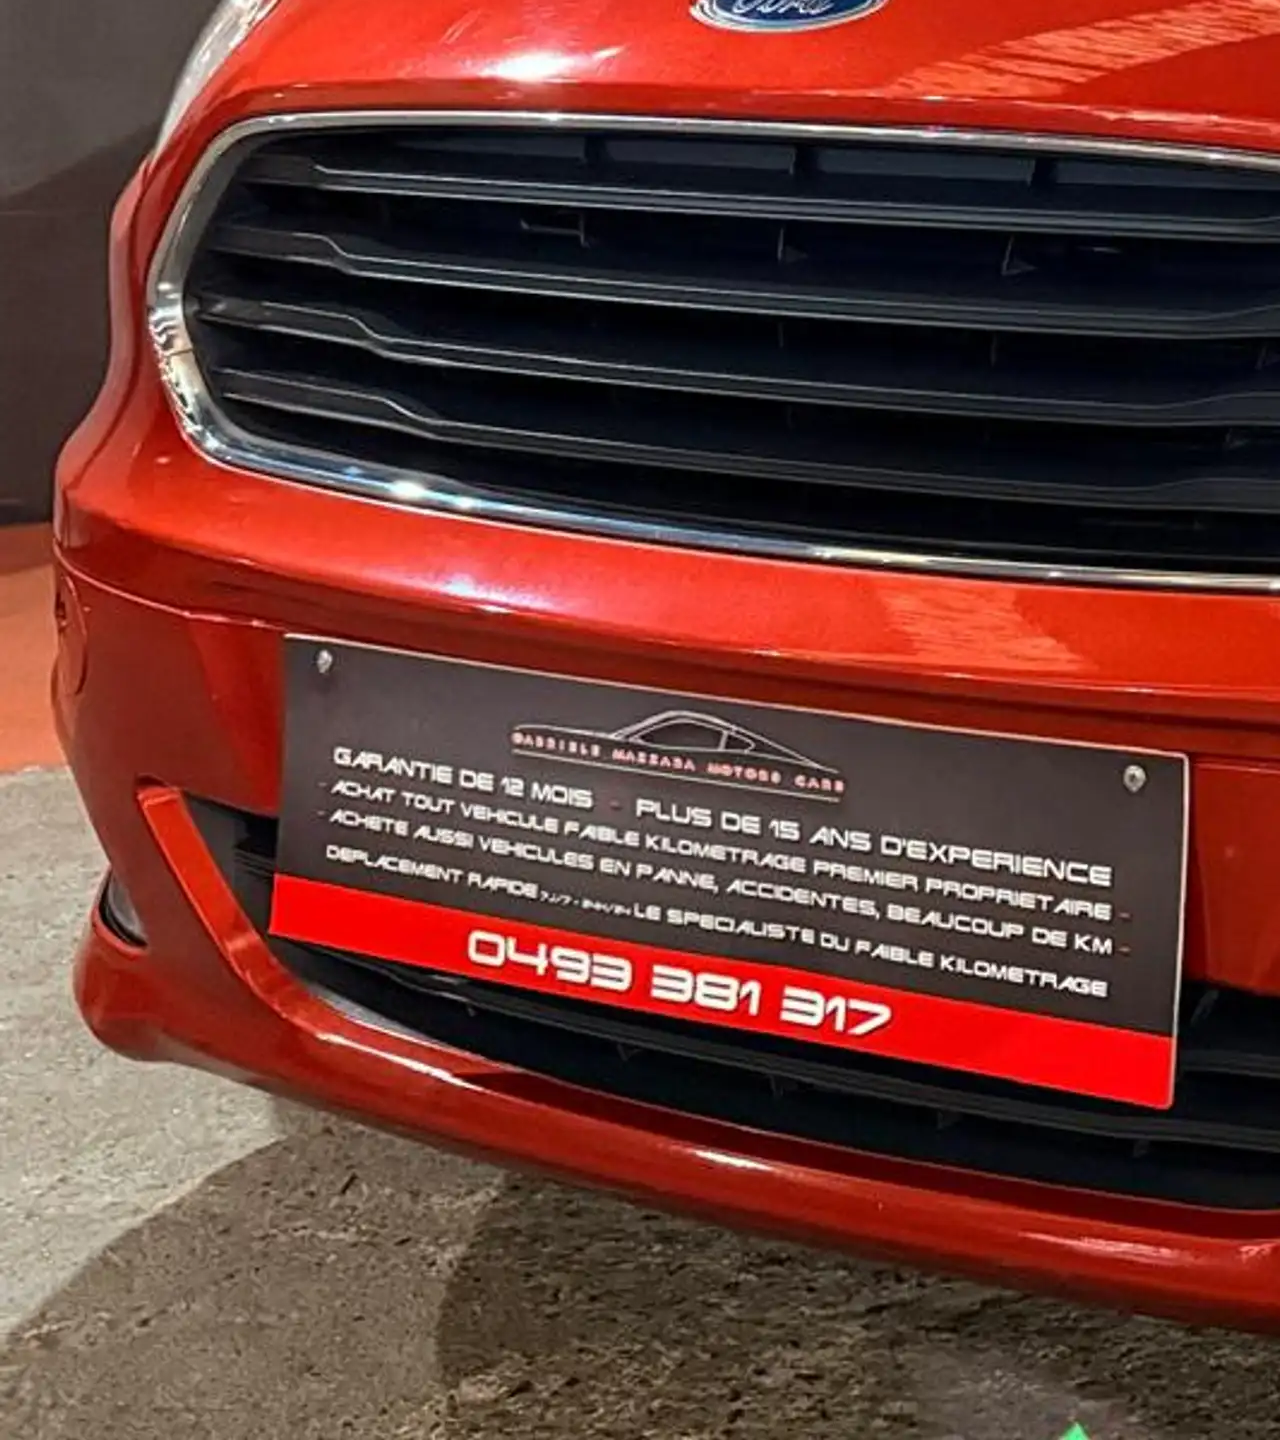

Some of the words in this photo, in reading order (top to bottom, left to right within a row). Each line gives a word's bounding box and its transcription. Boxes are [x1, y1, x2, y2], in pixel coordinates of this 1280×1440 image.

[333, 746, 453, 785] GARANTIE
[459, 768, 494, 792] DE
[500, 776, 525, 798] 12
[530, 781, 594, 809] MOIS
[636, 797, 712, 828] PLUS
[720, 812, 761, 836] DE
[768, 820, 800, 841] 15
[808, 826, 872, 853] ANS
[880, 834, 1112, 887] D'EXPERIENCE
[511, 731, 601, 758] GABRIELE
[707, 762, 782, 785] MOTORS
[794, 774, 845, 793] CARS
[326, 844, 464, 884] DEPLACEMENT
[467, 871, 539, 900] RAPIDE
[633, 902, 662, 923] LE
[666, 908, 815, 945] SPECIALISTE
[820, 932, 850, 952] DU
[854, 940, 935, 968] FAIBLE
[940, 954, 1108, 998] KILOMETRAGE
[330, 809, 408, 838] ACHETE
[413, 824, 474, 849] AUSSI
[478, 835, 595, 871] VEHICULES
[599, 858, 631, 877] EN
[887, 903, 1025, 940] BEAUCOUP
[1031, 926, 1068, 949] DE
[1074, 933, 1113, 956] KM
[331, 779, 396, 804] ACHAT
[401, 790, 455, 814] TOUT
[460, 801, 559, 835] VEHICULE
[645, 832, 807, 874] KILOMETRAGE
[812, 859, 918, 893] PREMIER
[925, 876, 1112, 922] PROPRIETAIRE
[466, 929, 632, 992] 0493
[650, 963, 762, 1016] 381
[779, 984, 892, 1036] 317
